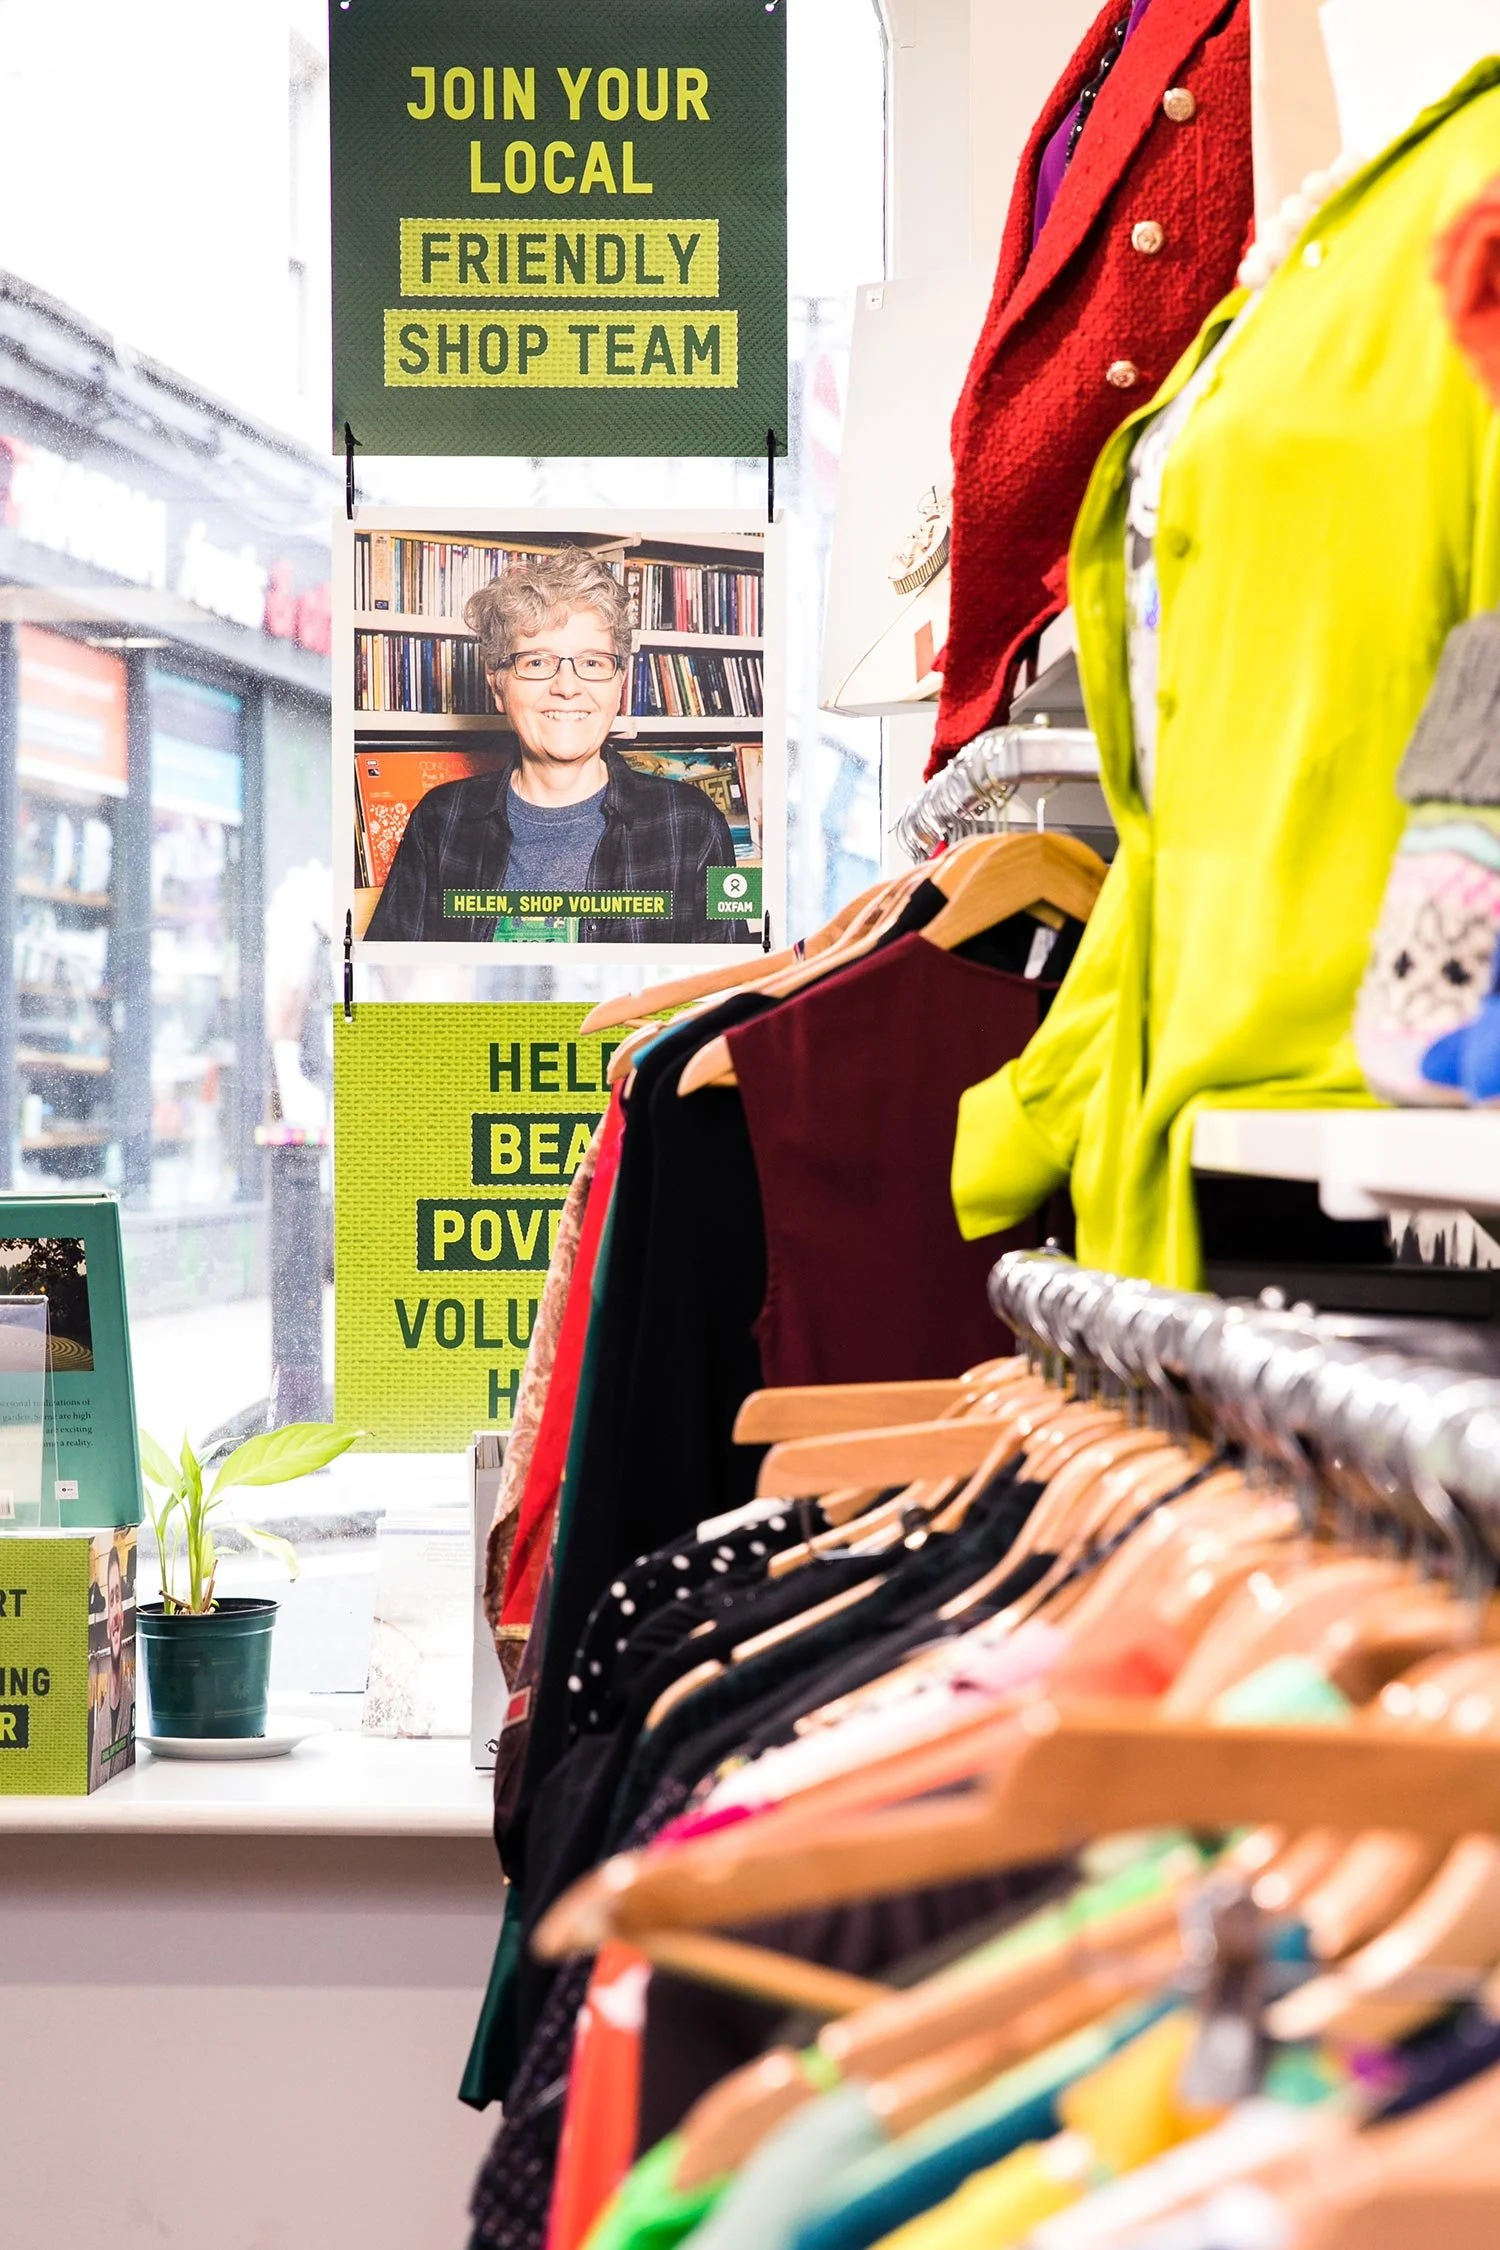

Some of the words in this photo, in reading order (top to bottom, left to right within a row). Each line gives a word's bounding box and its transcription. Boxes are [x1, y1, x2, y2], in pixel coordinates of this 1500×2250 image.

[406, 66, 535, 121] JOIN
[557, 67, 711, 121] YOUR
[470, 141, 653, 194] LOCAL
[422, 233, 701, 285] FRIENDLY
[398, 323, 548, 375] SHOP
[568, 325, 720, 375] TEAM
[454, 895, 513, 914] HELEN,
[519, 895, 564, 913] SHOP
[568, 896, 665, 913] VOLUNTEER
[717, 901, 753, 913] OXFAM
[490, 1123, 593, 1175] BEA
[394, 1298, 538, 1349] VOLU
[60, 1426, 93, 1435] exciting
[73, 1412, 91, 1420] high
